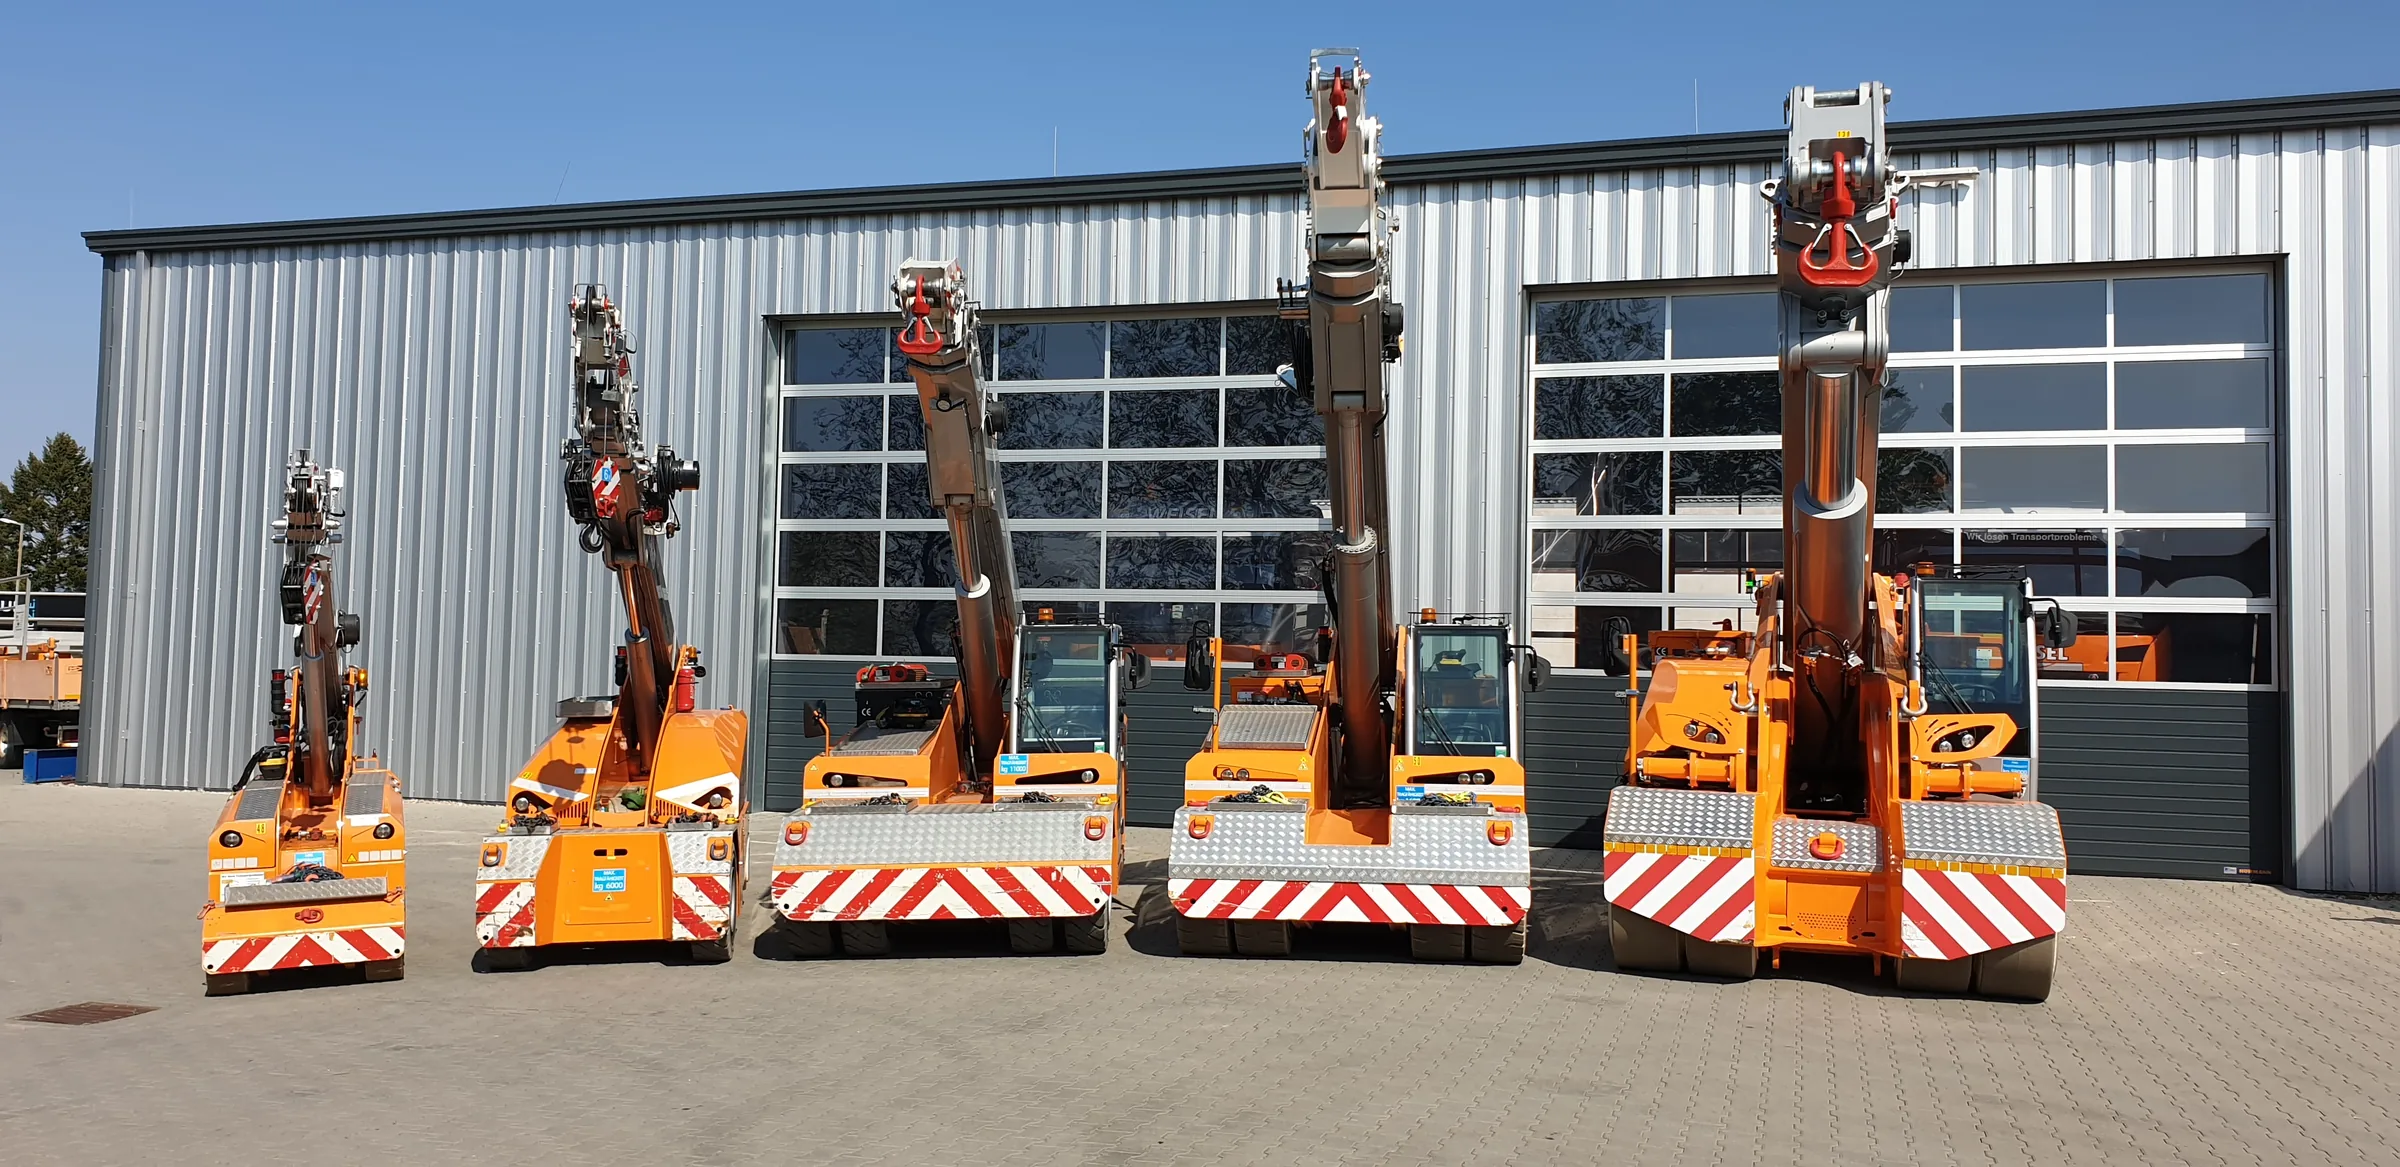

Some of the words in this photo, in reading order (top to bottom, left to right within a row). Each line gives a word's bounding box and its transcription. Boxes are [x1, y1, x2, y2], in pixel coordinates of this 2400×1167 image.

[1966, 532, 1982, 541] Wir
[2011, 532, 2097, 541] Transportprobleme
[1001, 765, 1008, 773] kg
[594, 881, 604, 891] kg
[605, 881, 624, 889] 6000
